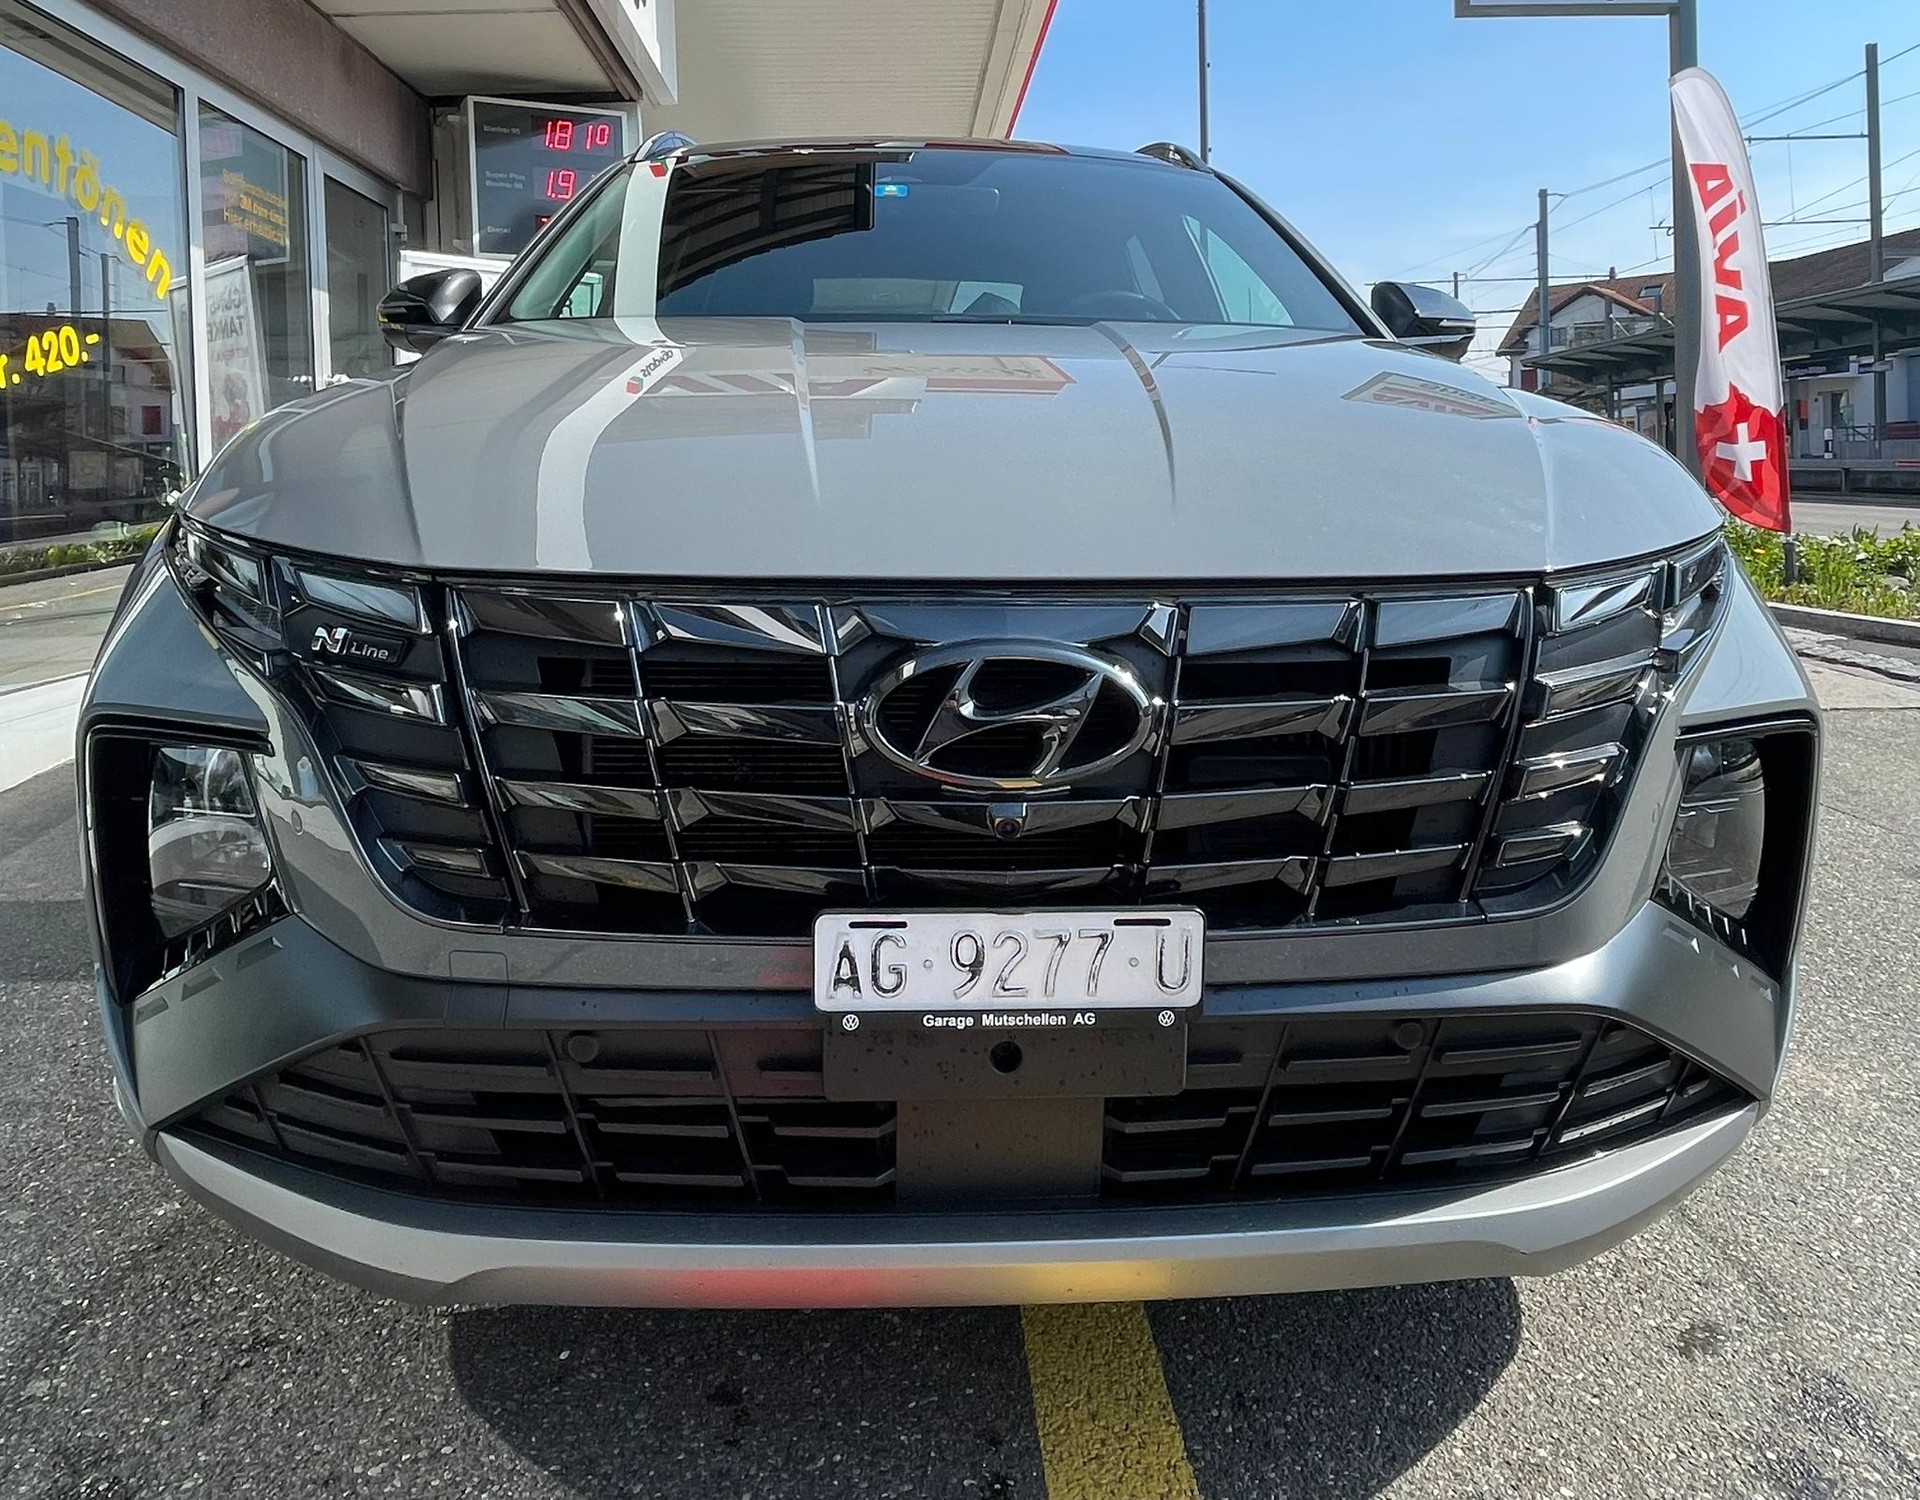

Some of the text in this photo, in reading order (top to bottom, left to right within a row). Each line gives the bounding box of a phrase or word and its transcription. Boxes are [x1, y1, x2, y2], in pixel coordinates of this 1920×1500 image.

[24, 325, 100, 377] 420.-
[350, 641, 389, 660] Line
[828, 928, 1193, 999] AG 9277 U
[922, 1013, 1097, 1029] Garage Mutschellen AG
